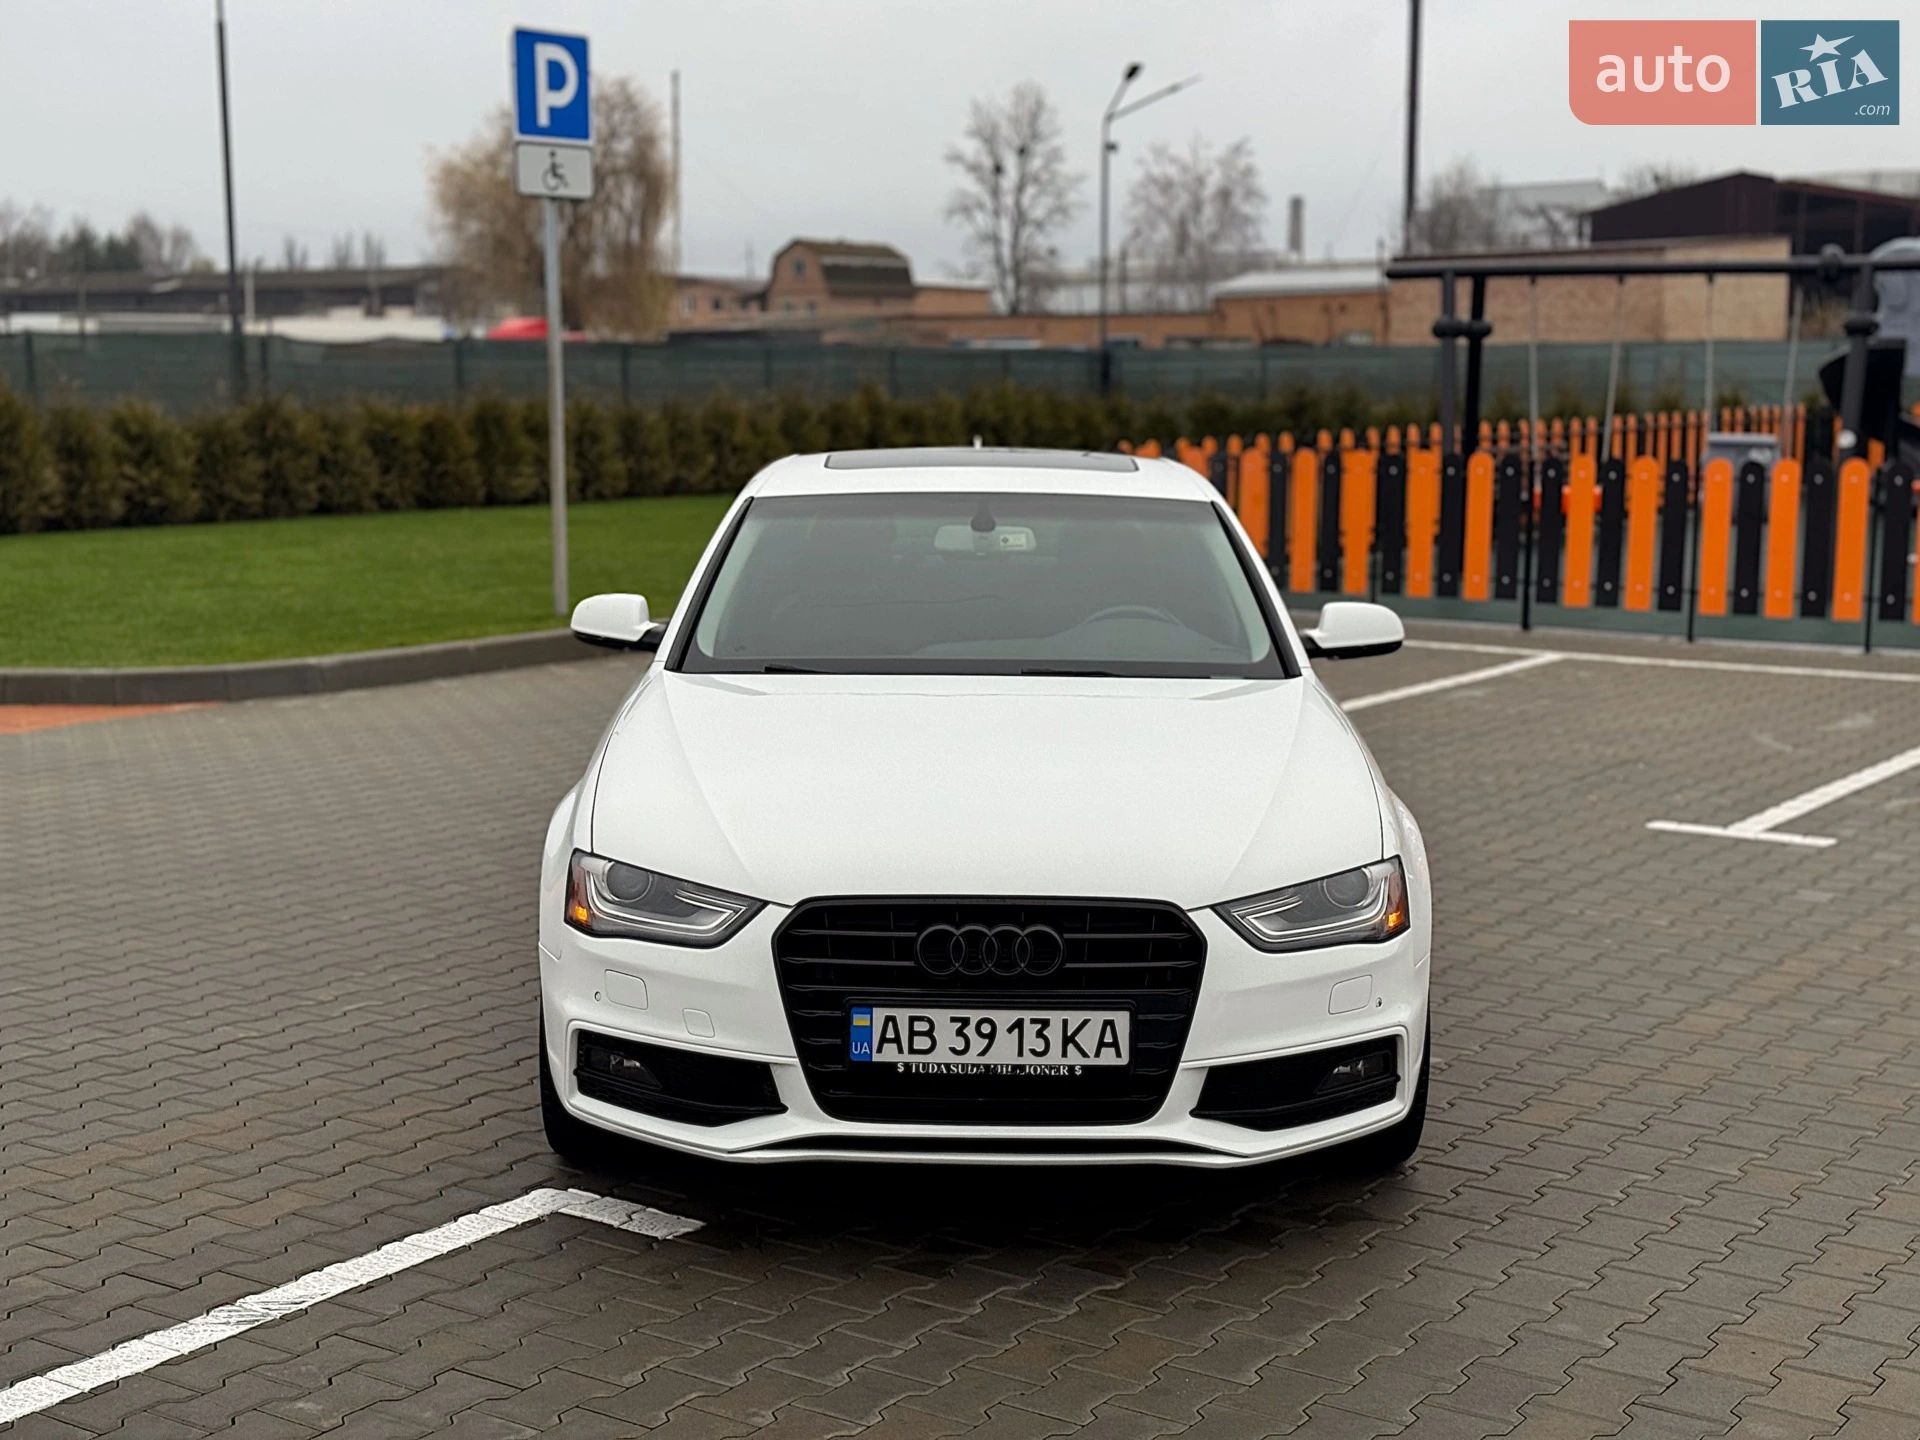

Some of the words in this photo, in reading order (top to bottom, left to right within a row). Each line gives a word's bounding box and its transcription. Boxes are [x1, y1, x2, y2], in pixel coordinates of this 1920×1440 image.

[533, 41, 579, 128] P
[852, 1042, 871, 1054] UA
[875, 1014, 938, 1055] AB
[948, 1016, 1051, 1058] 3913
[1060, 1018, 1123, 1059] KA
[909, 1062, 948, 1074] TUDA
